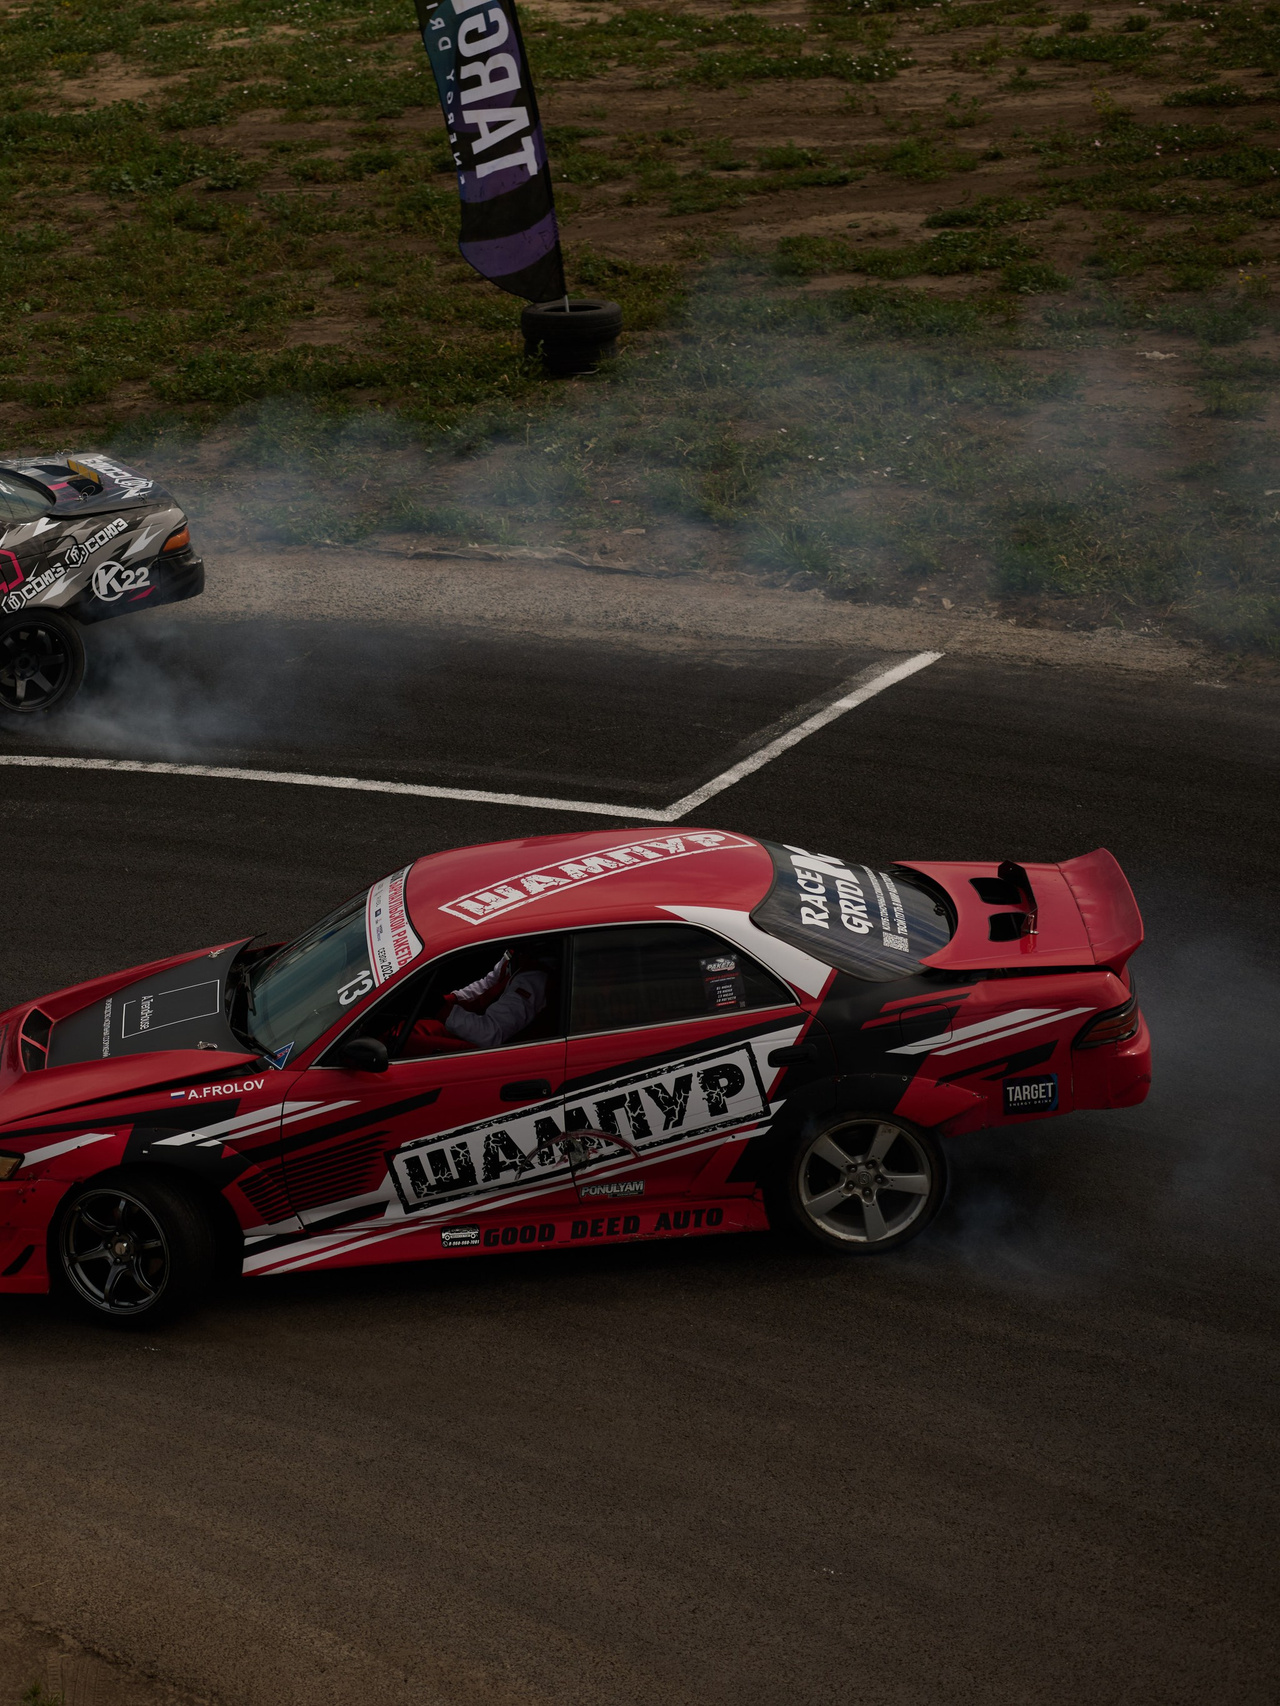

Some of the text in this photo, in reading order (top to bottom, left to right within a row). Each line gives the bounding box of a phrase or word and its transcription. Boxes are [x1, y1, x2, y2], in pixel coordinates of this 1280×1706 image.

[457, 833, 727, 916] ШАМПУР
[794, 867, 830, 930] RACE
[835, 879, 874, 934] GRID
[336, 970, 373, 1007] 13
[187, 1079, 266, 1101] A.FROLOV
[1006, 1082, 1054, 1102] TARGET
[402, 1063, 746, 1200] ШАМПУР
[580, 1179, 645, 1198] PONULYAM
[483, 1207, 724, 1247] GOOD DEED AUTO
